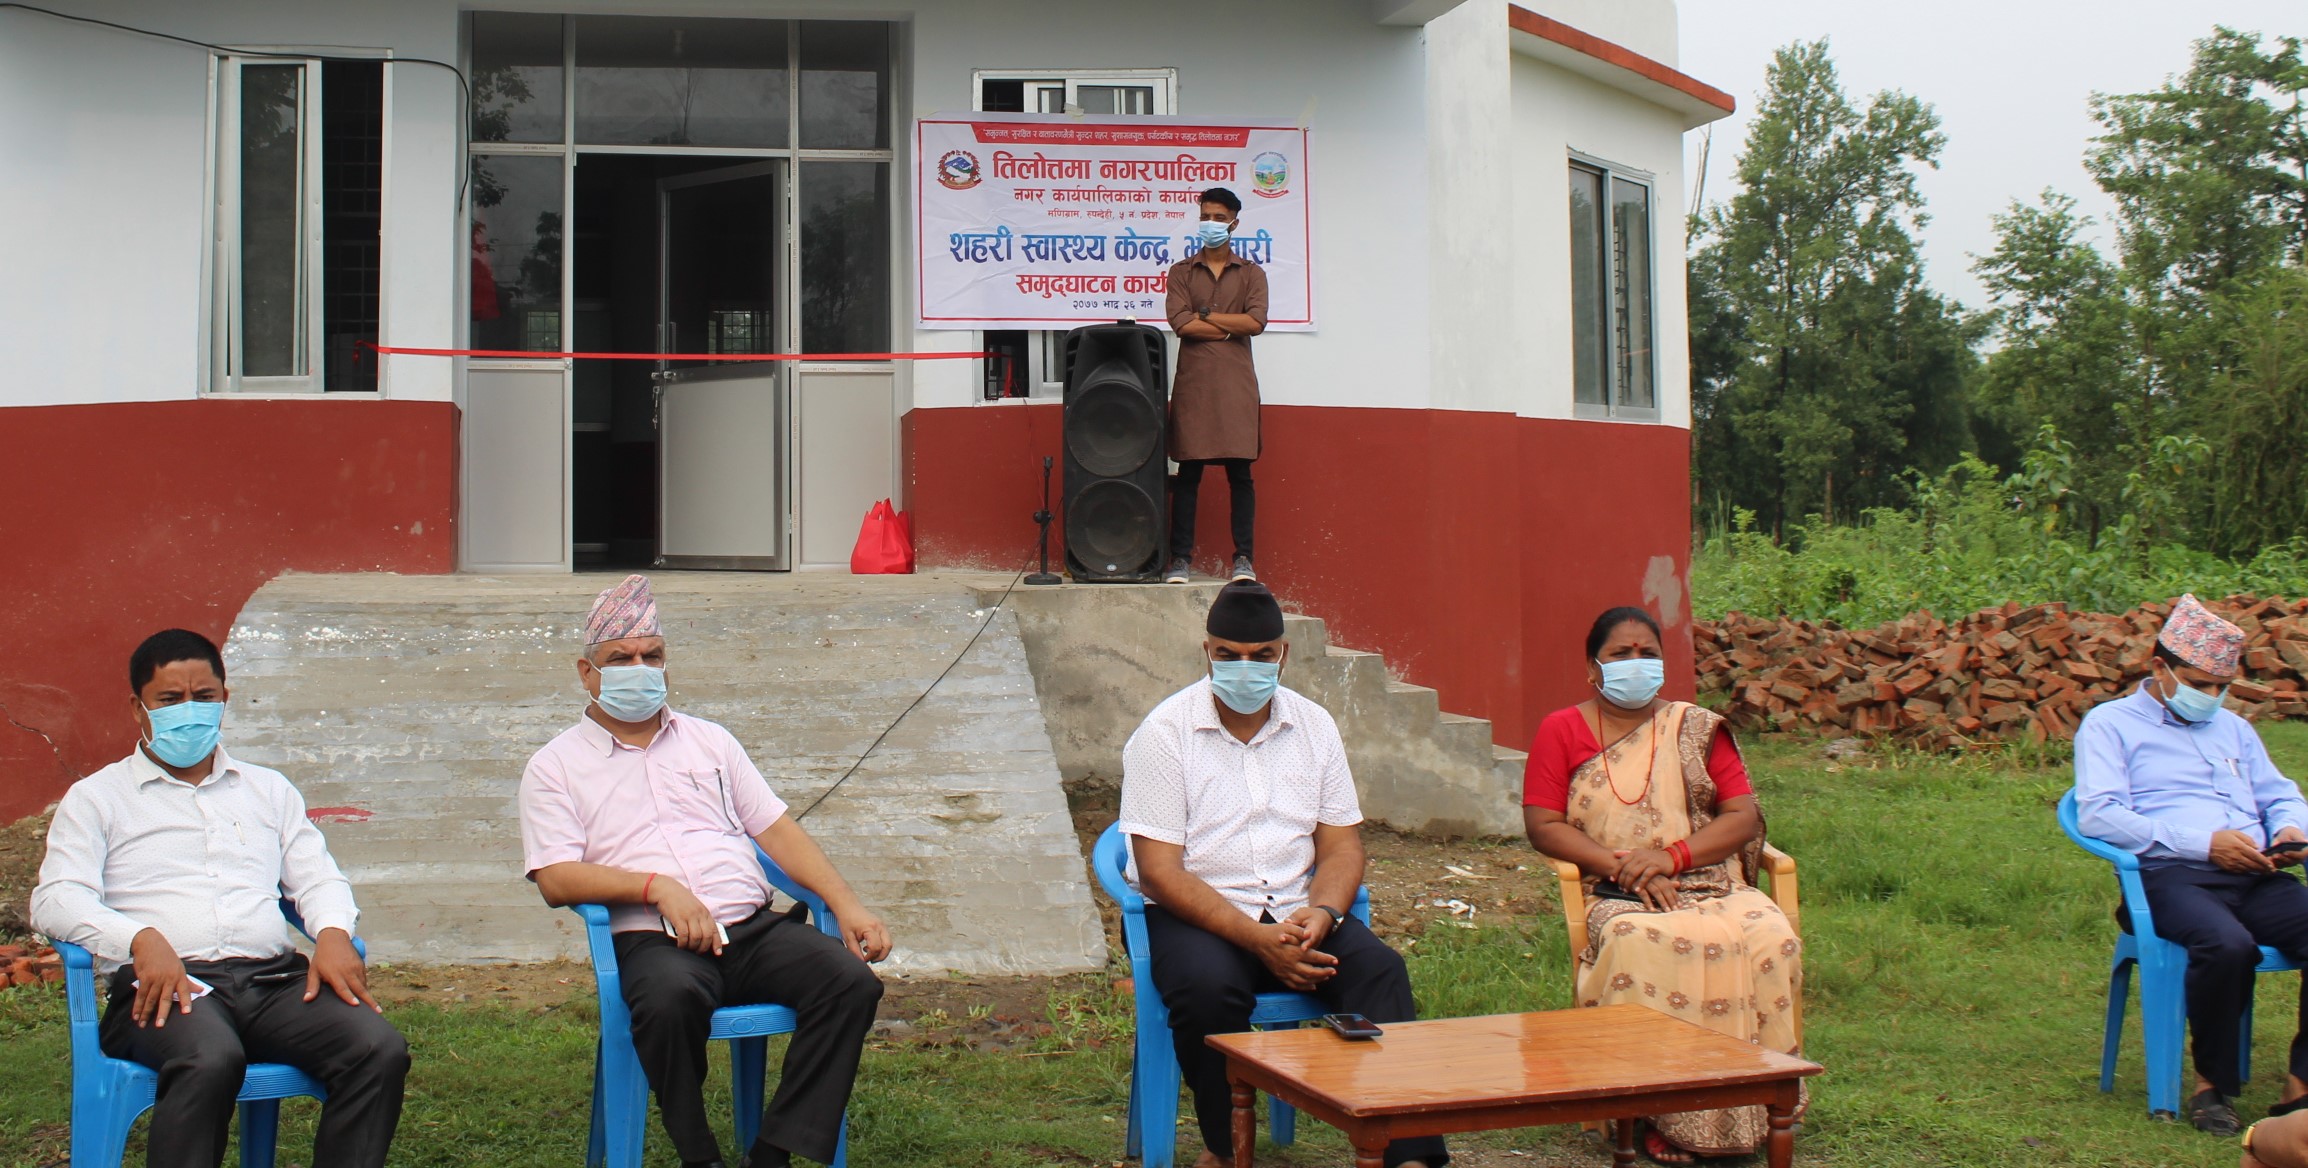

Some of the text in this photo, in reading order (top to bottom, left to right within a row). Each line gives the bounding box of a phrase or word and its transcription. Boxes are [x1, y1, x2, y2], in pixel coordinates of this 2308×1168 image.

[993, 150, 1091, 180] तिलोत्तमा
[1099, 153, 1236, 182] नगरपालिका
[1014, 184, 1206, 206] नगर कार्यपालिकाको कार्याल
[1164, 209, 1186, 219] नेपाल
[950, 225, 1013, 263] शहरी
[1021, 234, 1106, 263] स्वास्थ्य
[1114, 226, 1175, 265] केन्द्र,
[1123, 271, 1168, 294] कार्य
[1072, 298, 1154, 310] २०७७ भाद्र २६ गते
